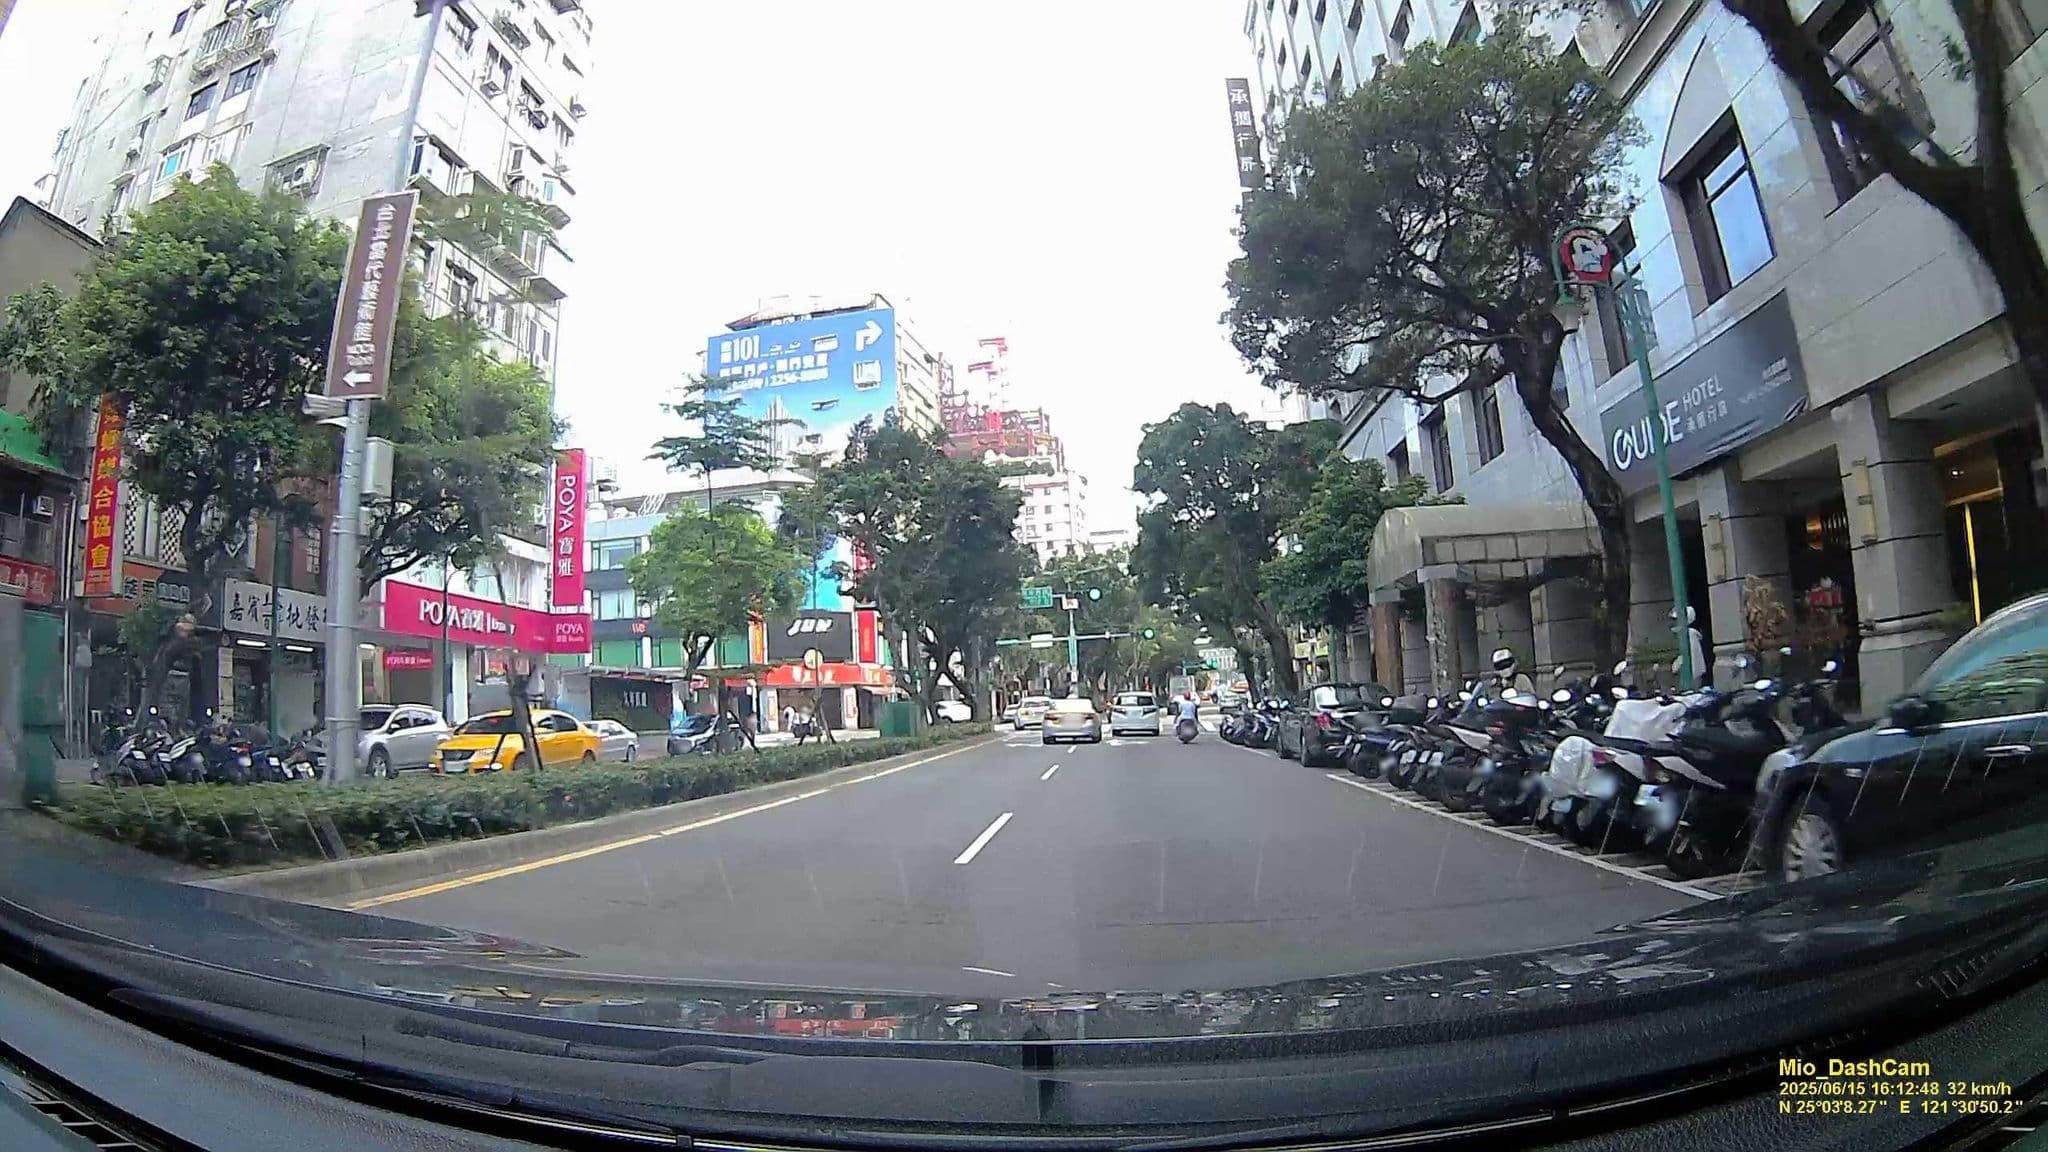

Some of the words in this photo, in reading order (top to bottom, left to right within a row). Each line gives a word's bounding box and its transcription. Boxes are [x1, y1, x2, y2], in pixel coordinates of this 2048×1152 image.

[733, 335, 760, 361] 101
[1682, 374, 1724, 412] HOTEL
[558, 475, 577, 533] POYA
[555, 623, 585, 634] POYA
